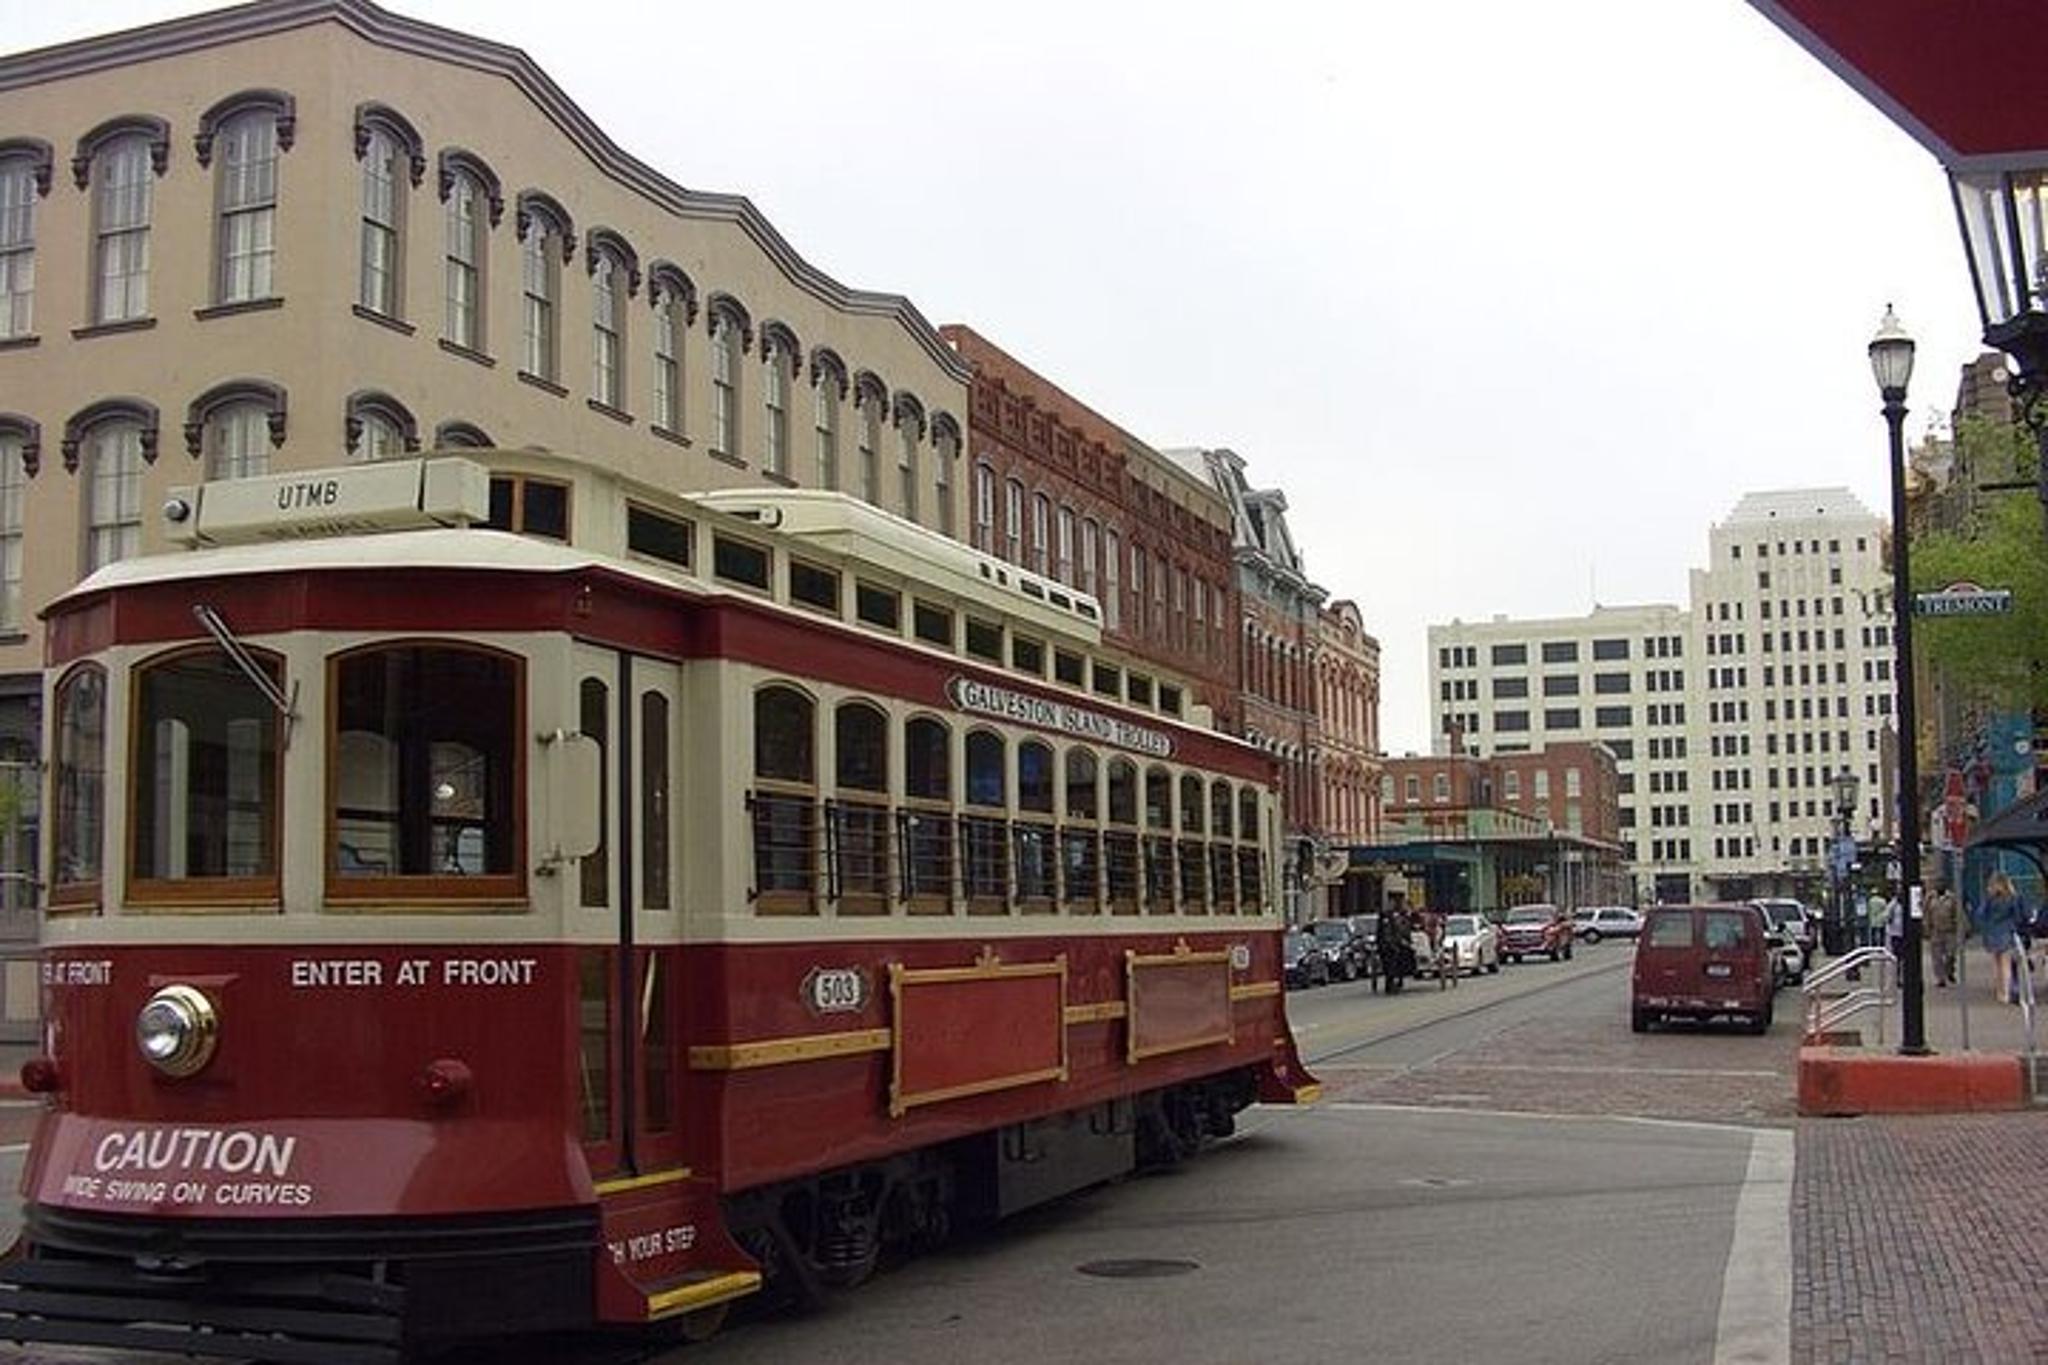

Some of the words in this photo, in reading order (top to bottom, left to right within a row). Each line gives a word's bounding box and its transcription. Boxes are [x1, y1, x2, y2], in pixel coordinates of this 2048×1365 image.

[278, 480, 338, 509] UTMB
[964, 681, 1057, 726] GALVESTON
[1060, 704, 1114, 738] ISLAND
[67, 960, 113, 985] FRONT
[291, 960, 383, 986] ENTER
[396, 960, 431, 985] AT
[444, 959, 537, 985] FRONT
[821, 975, 855, 1005] 503
[94, 1129, 296, 1176] CAUTION
[104, 1180, 167, 1201] SWING
[172, 1181, 208, 1203] ON
[214, 1183, 313, 1205] CURVES
[628, 1233, 663, 1261] YOUR
[665, 1225, 695, 1252] STEP
